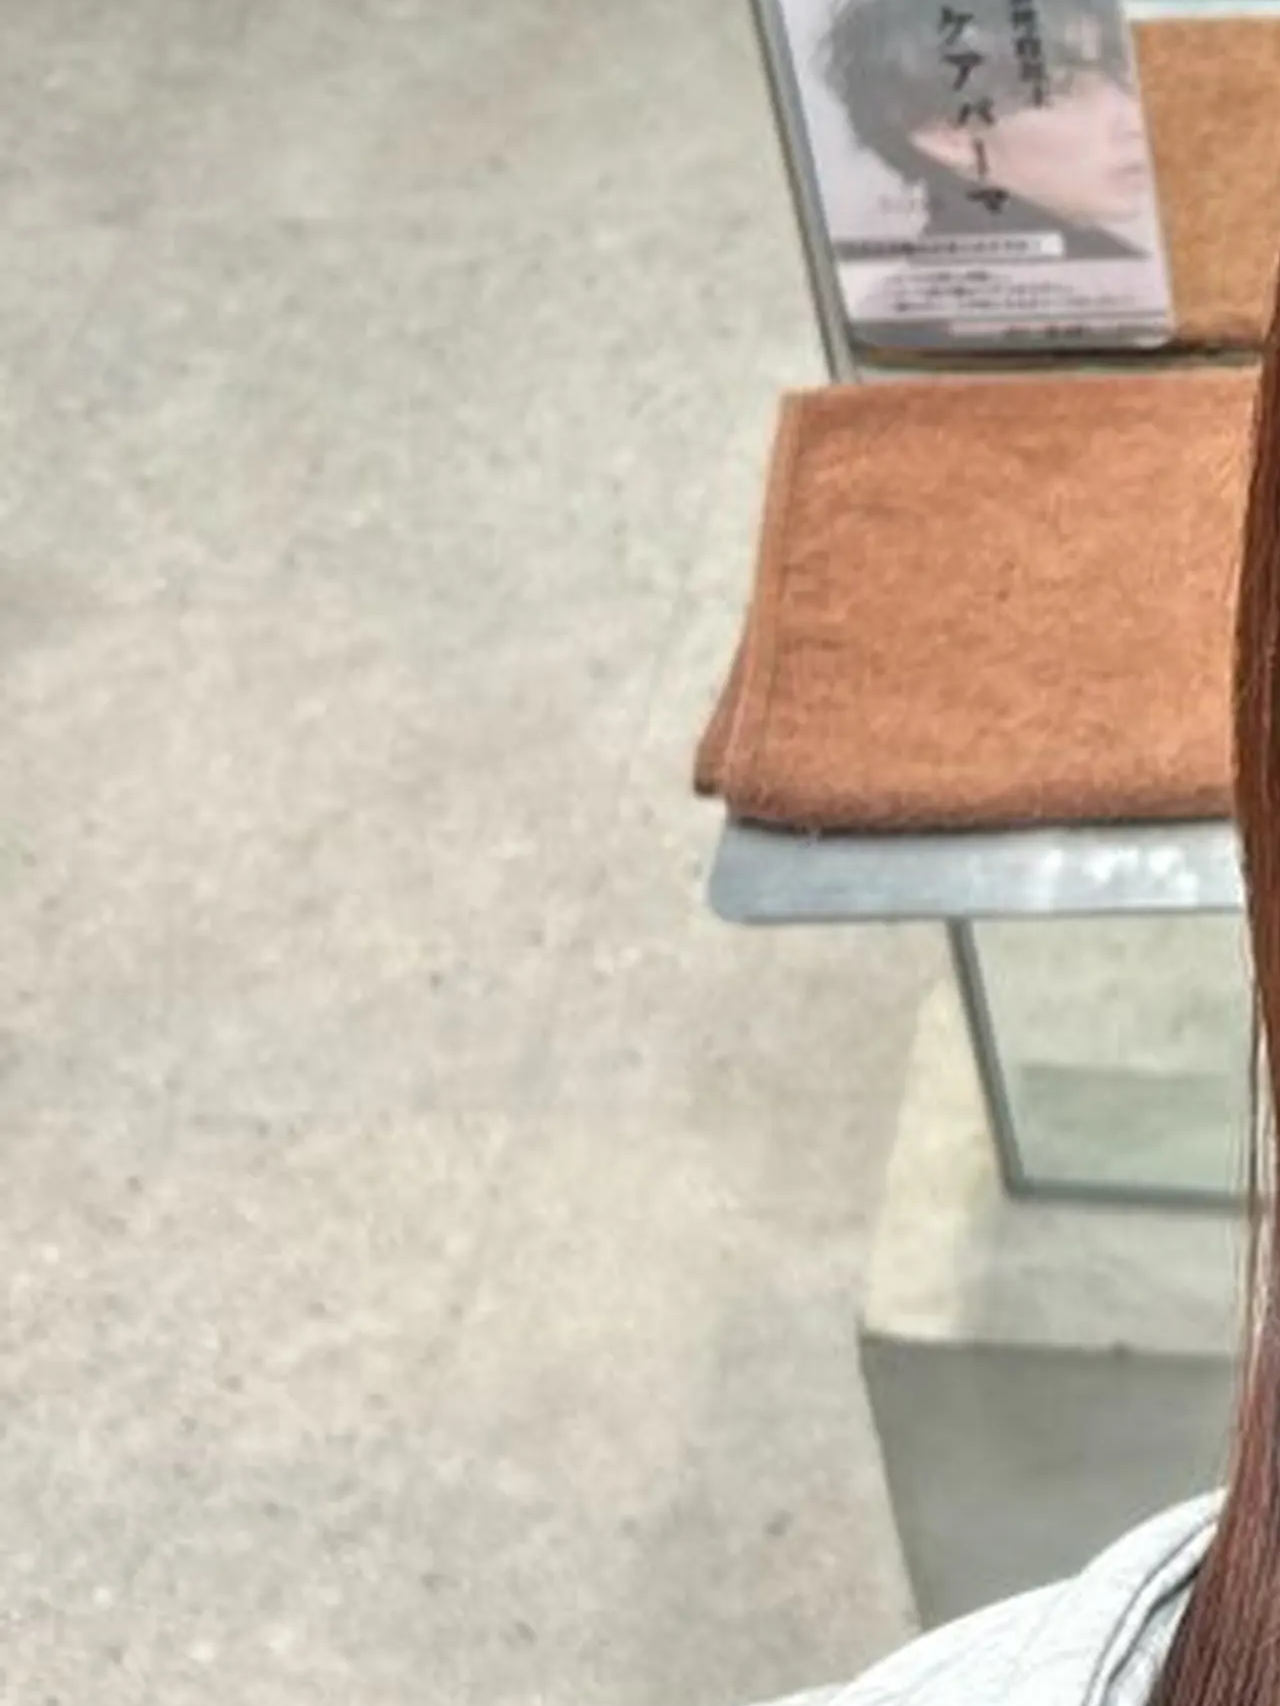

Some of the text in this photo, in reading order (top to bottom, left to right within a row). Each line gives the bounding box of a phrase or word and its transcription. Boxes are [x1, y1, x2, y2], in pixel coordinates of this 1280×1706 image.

[937, 4, 1011, 216] ケアパーマ
